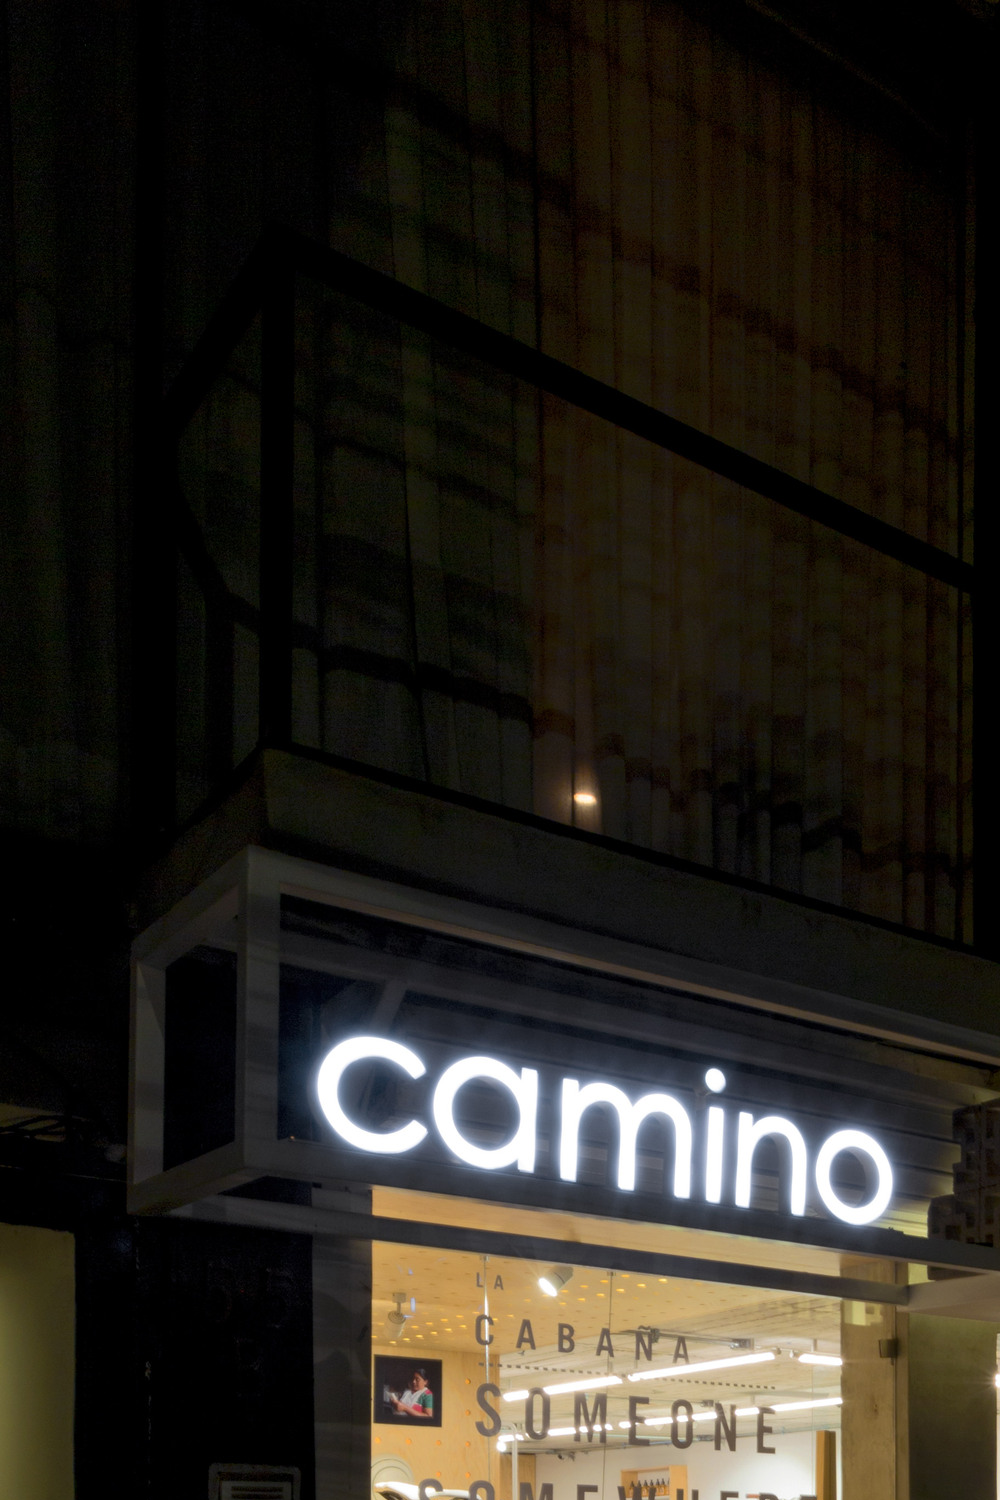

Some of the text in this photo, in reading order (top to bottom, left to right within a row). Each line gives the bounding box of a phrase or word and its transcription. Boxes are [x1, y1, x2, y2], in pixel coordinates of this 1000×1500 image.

[316, 1036, 894, 1226] camino
[475, 1272, 505, 1292] LA
[475, 1314, 690, 1364] CABAÑA
[475, 1383, 777, 1454] SOMEONE
